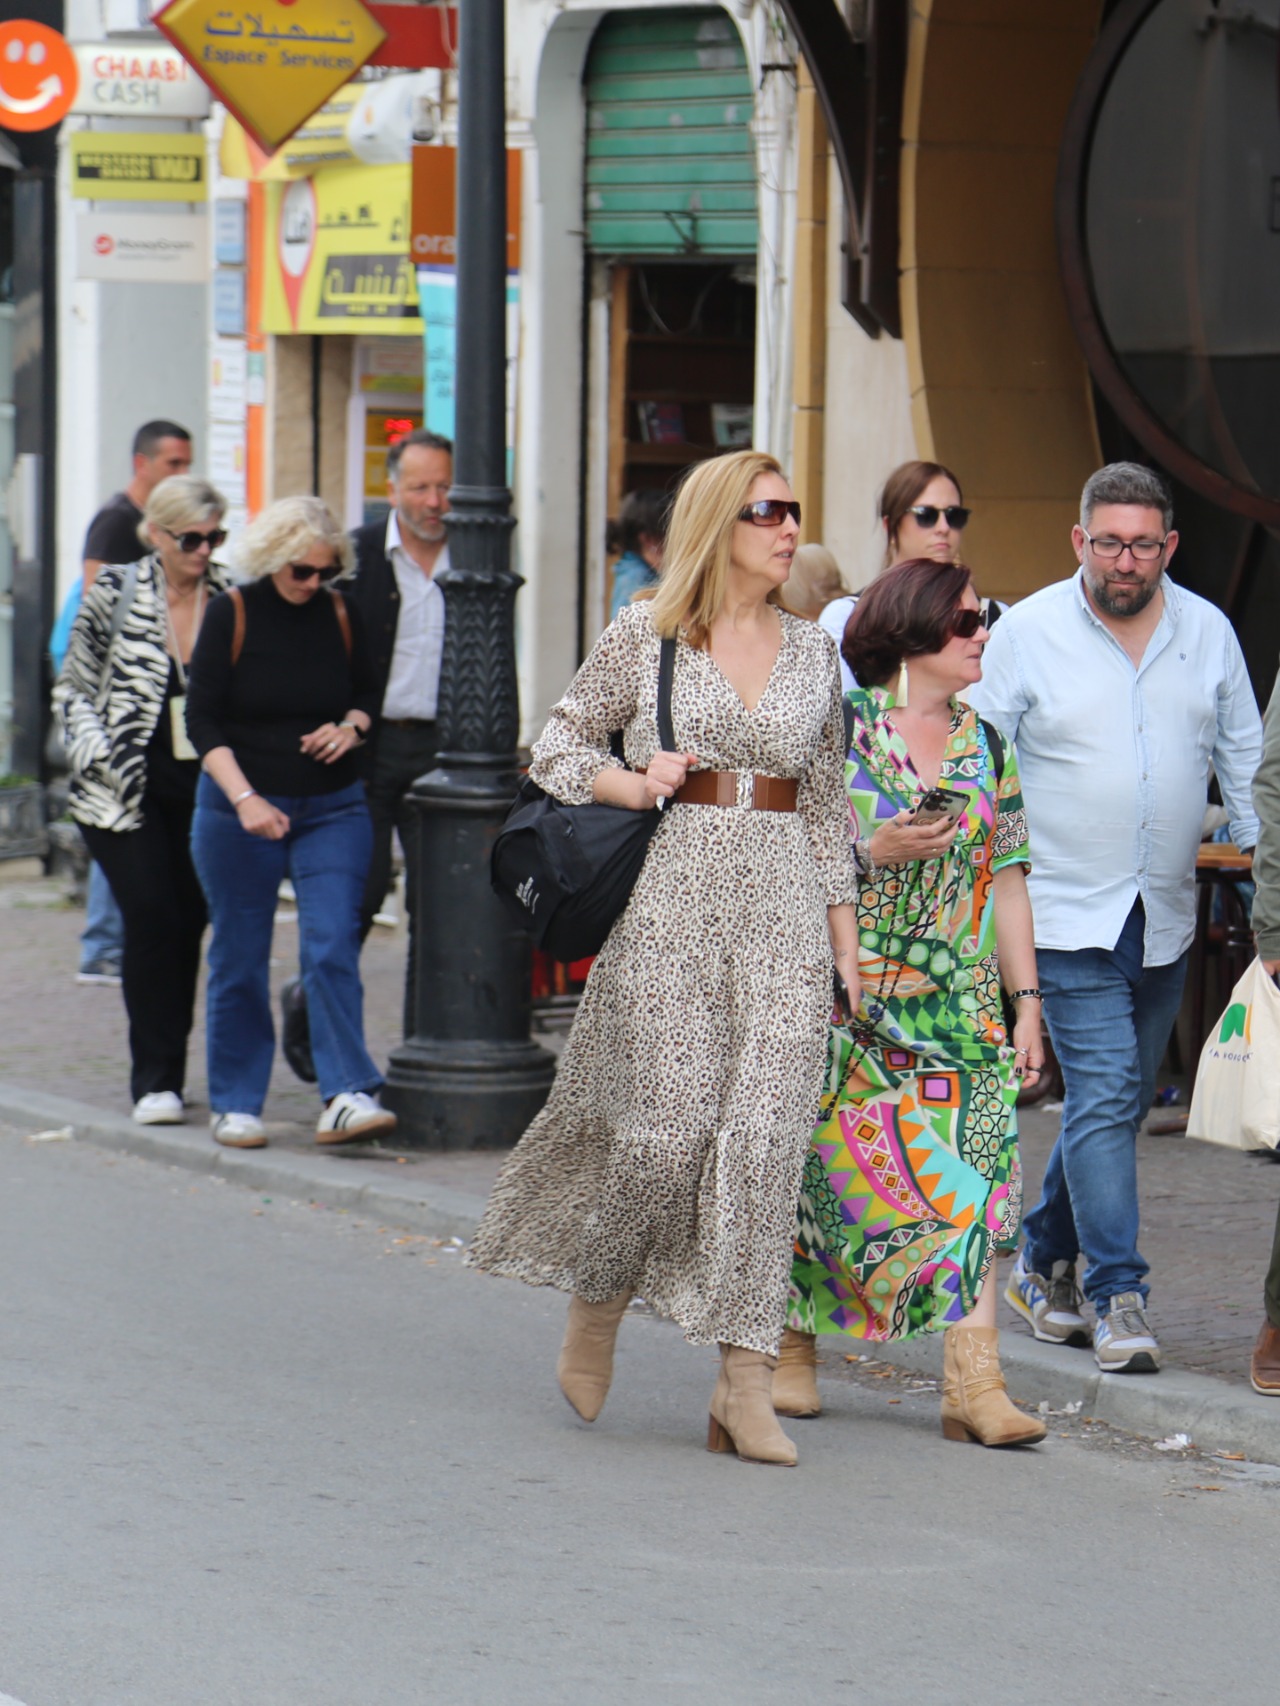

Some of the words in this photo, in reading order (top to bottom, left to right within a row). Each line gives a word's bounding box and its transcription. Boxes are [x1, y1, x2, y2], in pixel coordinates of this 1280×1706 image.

[205, 12, 354, 46] تسهيلات
[93, 55, 188, 81] CHAABI
[203, 46, 267, 65] Espace
[280, 51, 354, 69] Services
[93, 81, 161, 105] CASH
[413, 233, 457, 254] ora
